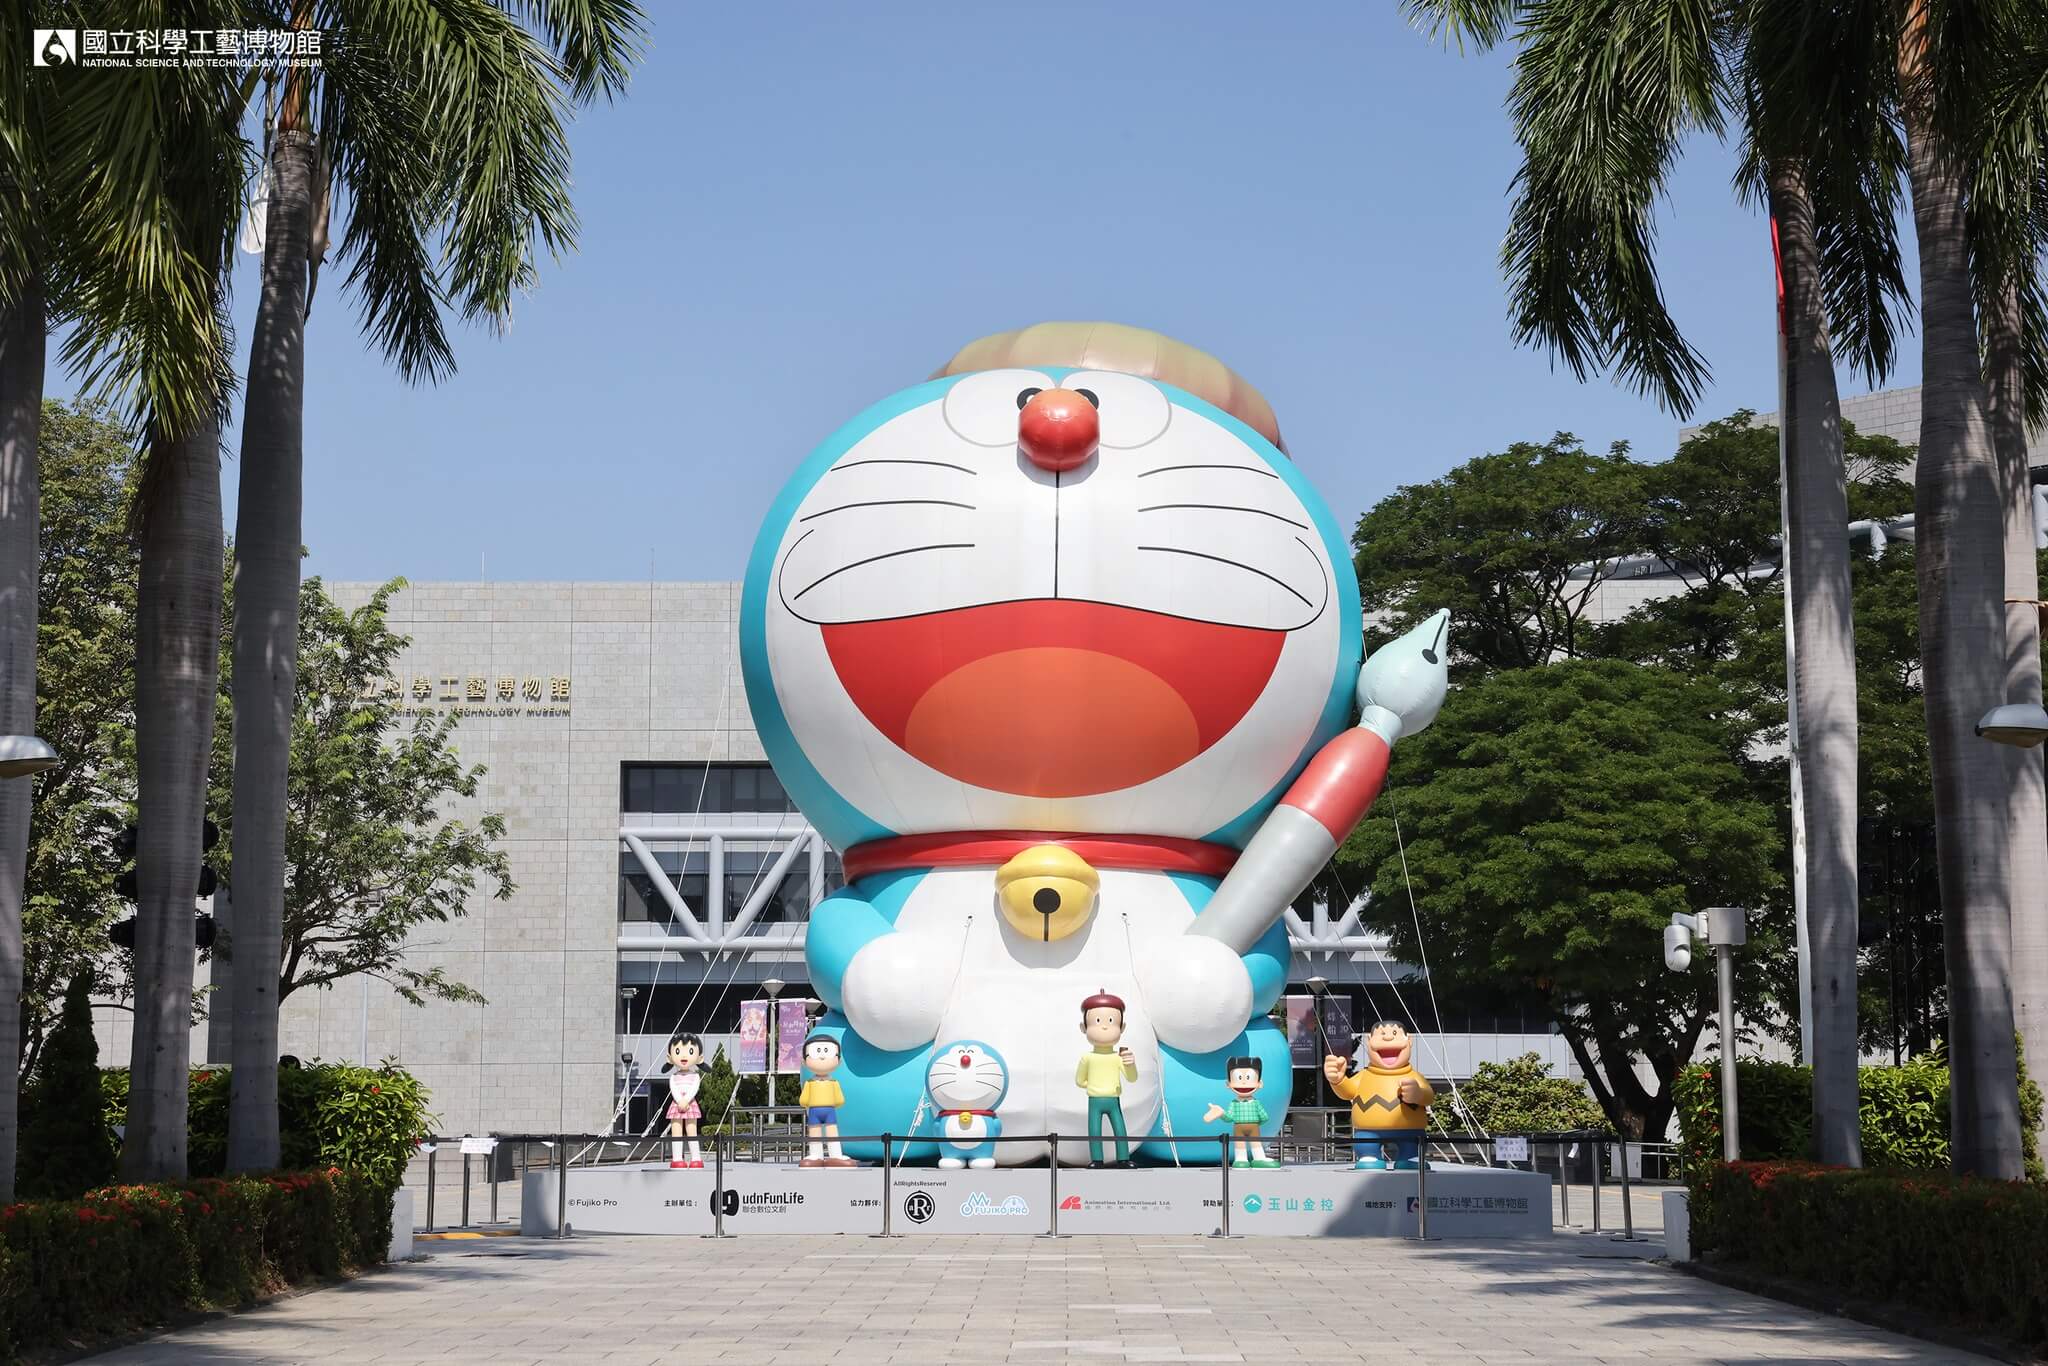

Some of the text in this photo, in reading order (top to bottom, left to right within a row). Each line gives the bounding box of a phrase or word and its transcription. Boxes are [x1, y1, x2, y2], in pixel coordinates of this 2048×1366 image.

[526, 704, 570, 717] MUSEUM
[742, 1192, 804, 1205] udnFunLife
[1268, 1197, 1334, 1212] 玉山金控
[974, 1207, 1029, 1215] FUJIKO PRO
